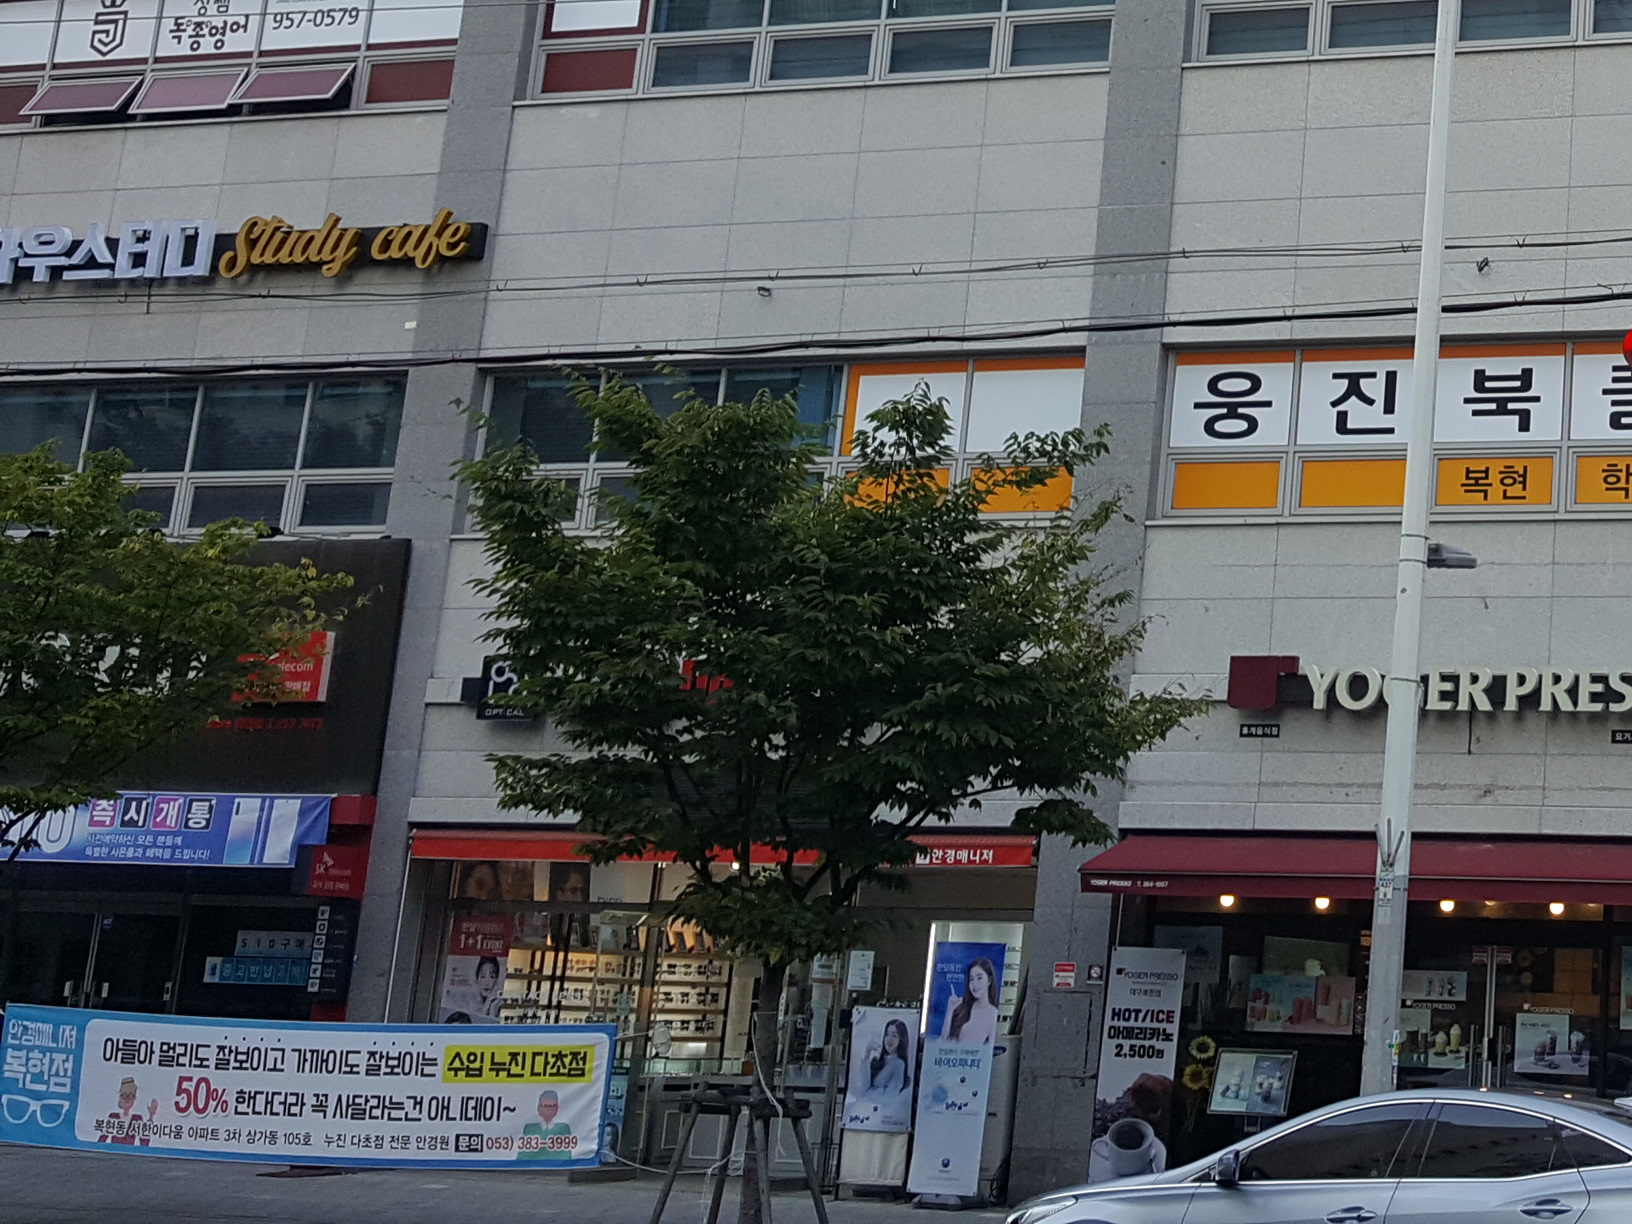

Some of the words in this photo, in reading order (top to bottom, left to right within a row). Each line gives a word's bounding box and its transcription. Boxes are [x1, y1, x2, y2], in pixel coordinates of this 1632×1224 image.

[272, 6, 360, 31] 957-0579
[218, 212, 360, 278] Study
[370, 207, 471, 271] cafe
[1459, 464, 1529, 502] 복현
[931, 848, 994, 864] 안경매니져
[1110, 1007, 1176, 1024] HOT/ICE
[1107, 1025, 1174, 1042] 아메리카노
[102, 1037, 155, 1066] 아들아
[158, 1041, 211, 1069] 멀리도
[214, 1043, 286, 1073] 잘보이고
[291, 1047, 362, 1076] 가까이도
[365, 1049, 438, 1078] 잘보이는
[447, 1051, 485, 1078] 수입
[488, 1052, 527, 1078] 누진
[530, 1051, 587, 1078] 다초점
[1113, 1043, 1165, 1059] 2,500원
[3, 1047, 75, 1094] 복현점
[174, 1075, 229, 1116] 50%
[234, 1089, 306, 1118] 한다더라
[310, 1092, 329, 1120] 꼭
[94, 1118, 127, 1137] 복현동
[187, 1126, 221, 1141] 아파트
[223, 1129, 243, 1144] 3차
[246, 1130, 279, 1146] 상가동
[282, 1131, 313, 1146] 105호
[324, 1133, 348, 1149] 누진
[350, 1134, 385, 1150] 다초점
[388, 1134, 412, 1150] 전문
[415, 1134, 450, 1151] 안경원
[457, 1135, 482, 1151] 문의
[486, 1135, 515, 1151] 053)
[517, 1134, 579, 1150] 383-3999
